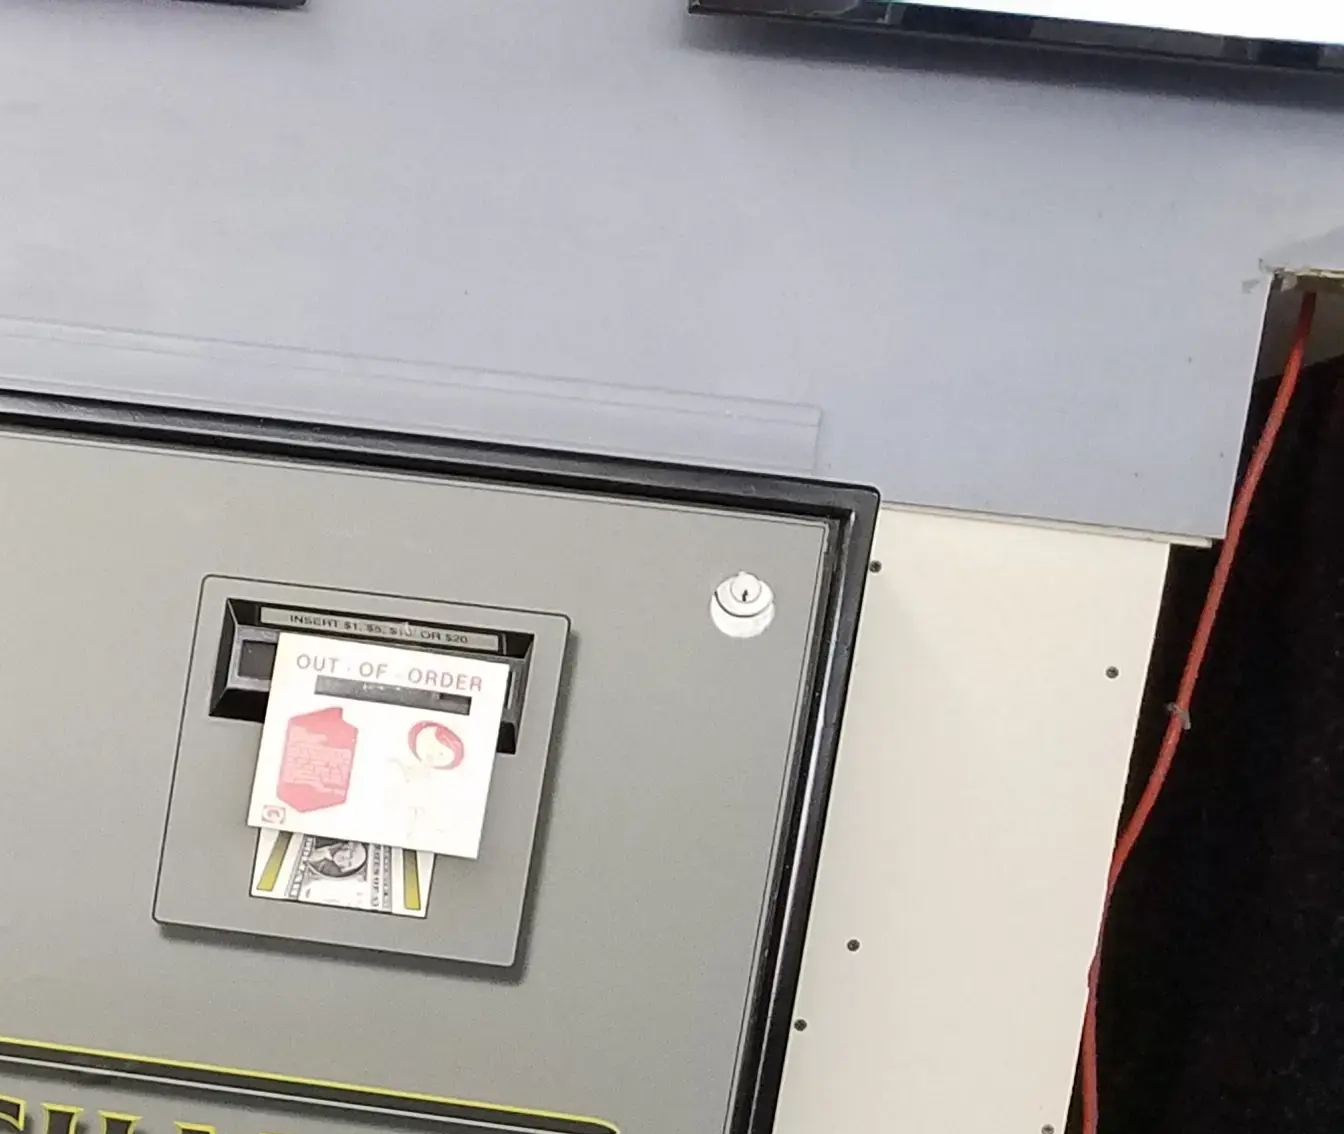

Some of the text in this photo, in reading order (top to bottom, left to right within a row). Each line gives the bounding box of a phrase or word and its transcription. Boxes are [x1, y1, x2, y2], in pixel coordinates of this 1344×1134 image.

[289, 614, 339, 629] INSERT
[420, 629, 441, 641] OR
[445, 633, 469, 644] $20
[296, 653, 483, 692] OUT OF ORDER
